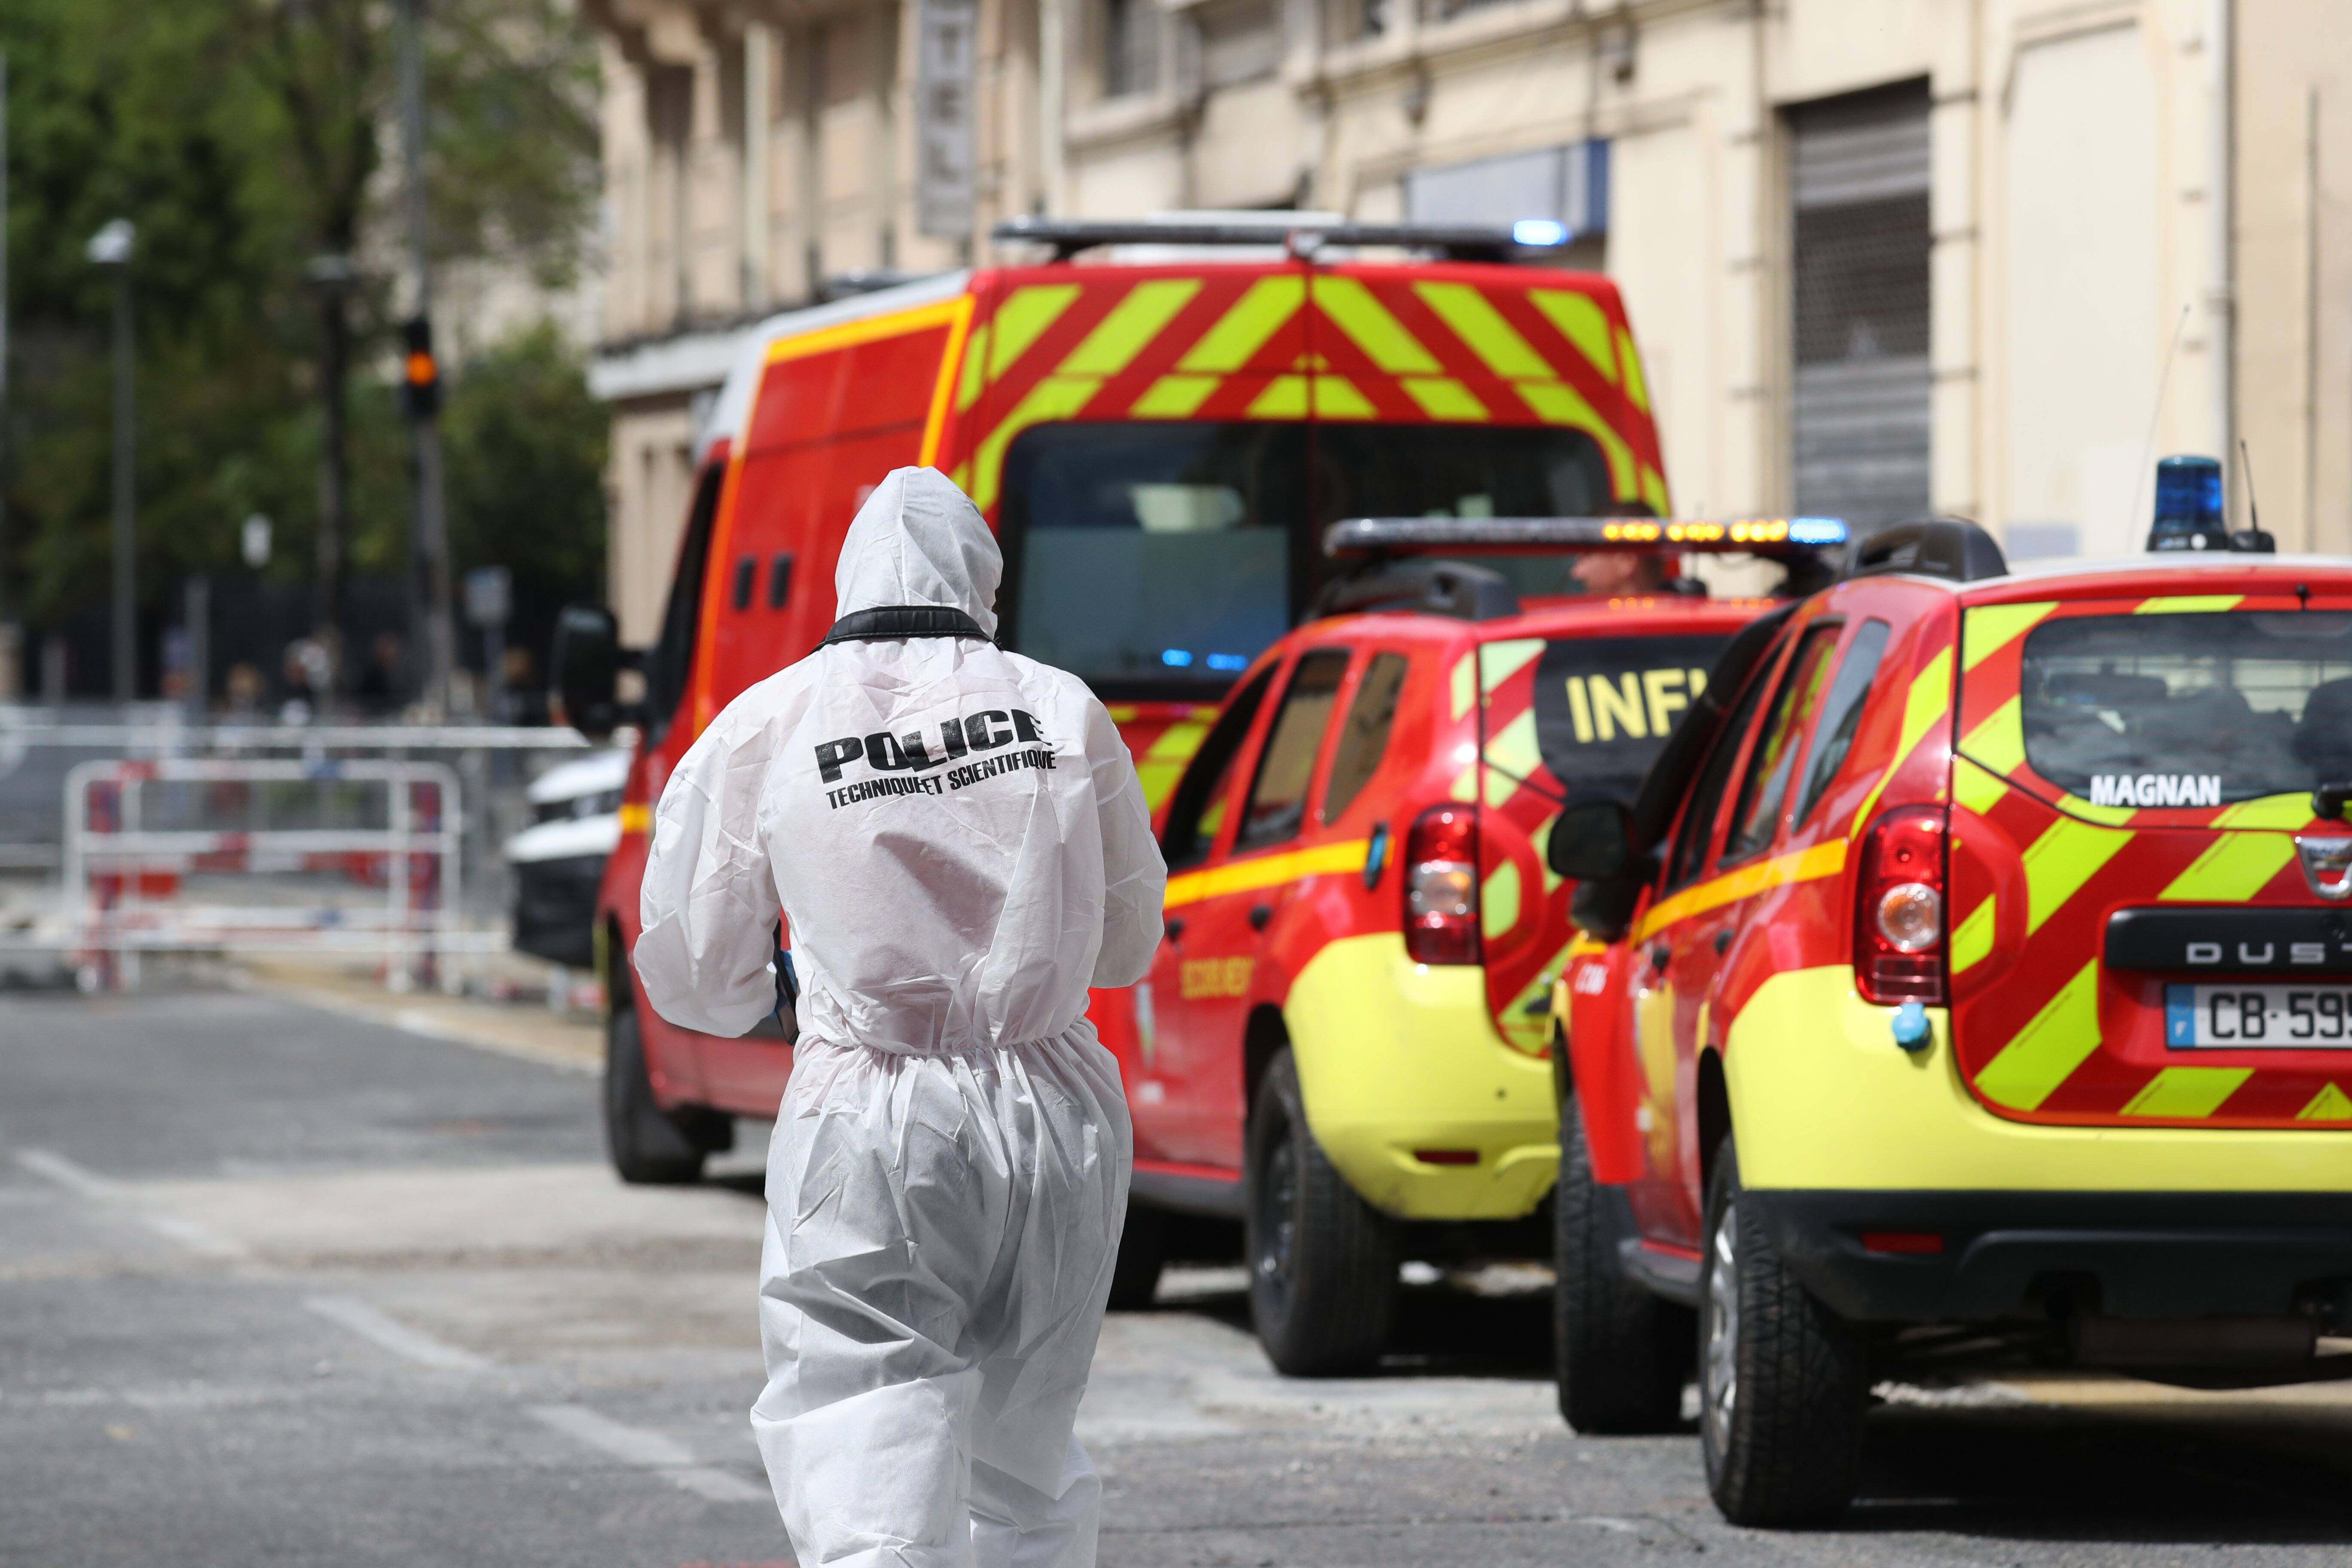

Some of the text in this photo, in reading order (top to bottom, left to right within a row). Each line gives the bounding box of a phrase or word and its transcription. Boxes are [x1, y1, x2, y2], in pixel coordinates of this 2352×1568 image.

[814, 708, 1053, 784] POLICE
[826, 776, 925, 809] TECHNIQUE
[947, 749, 1057, 790] SCIENTIFIQUE
[2090, 775, 2221, 806] MAGNAN
[2210, 993, 2352, 1038] CB-59
